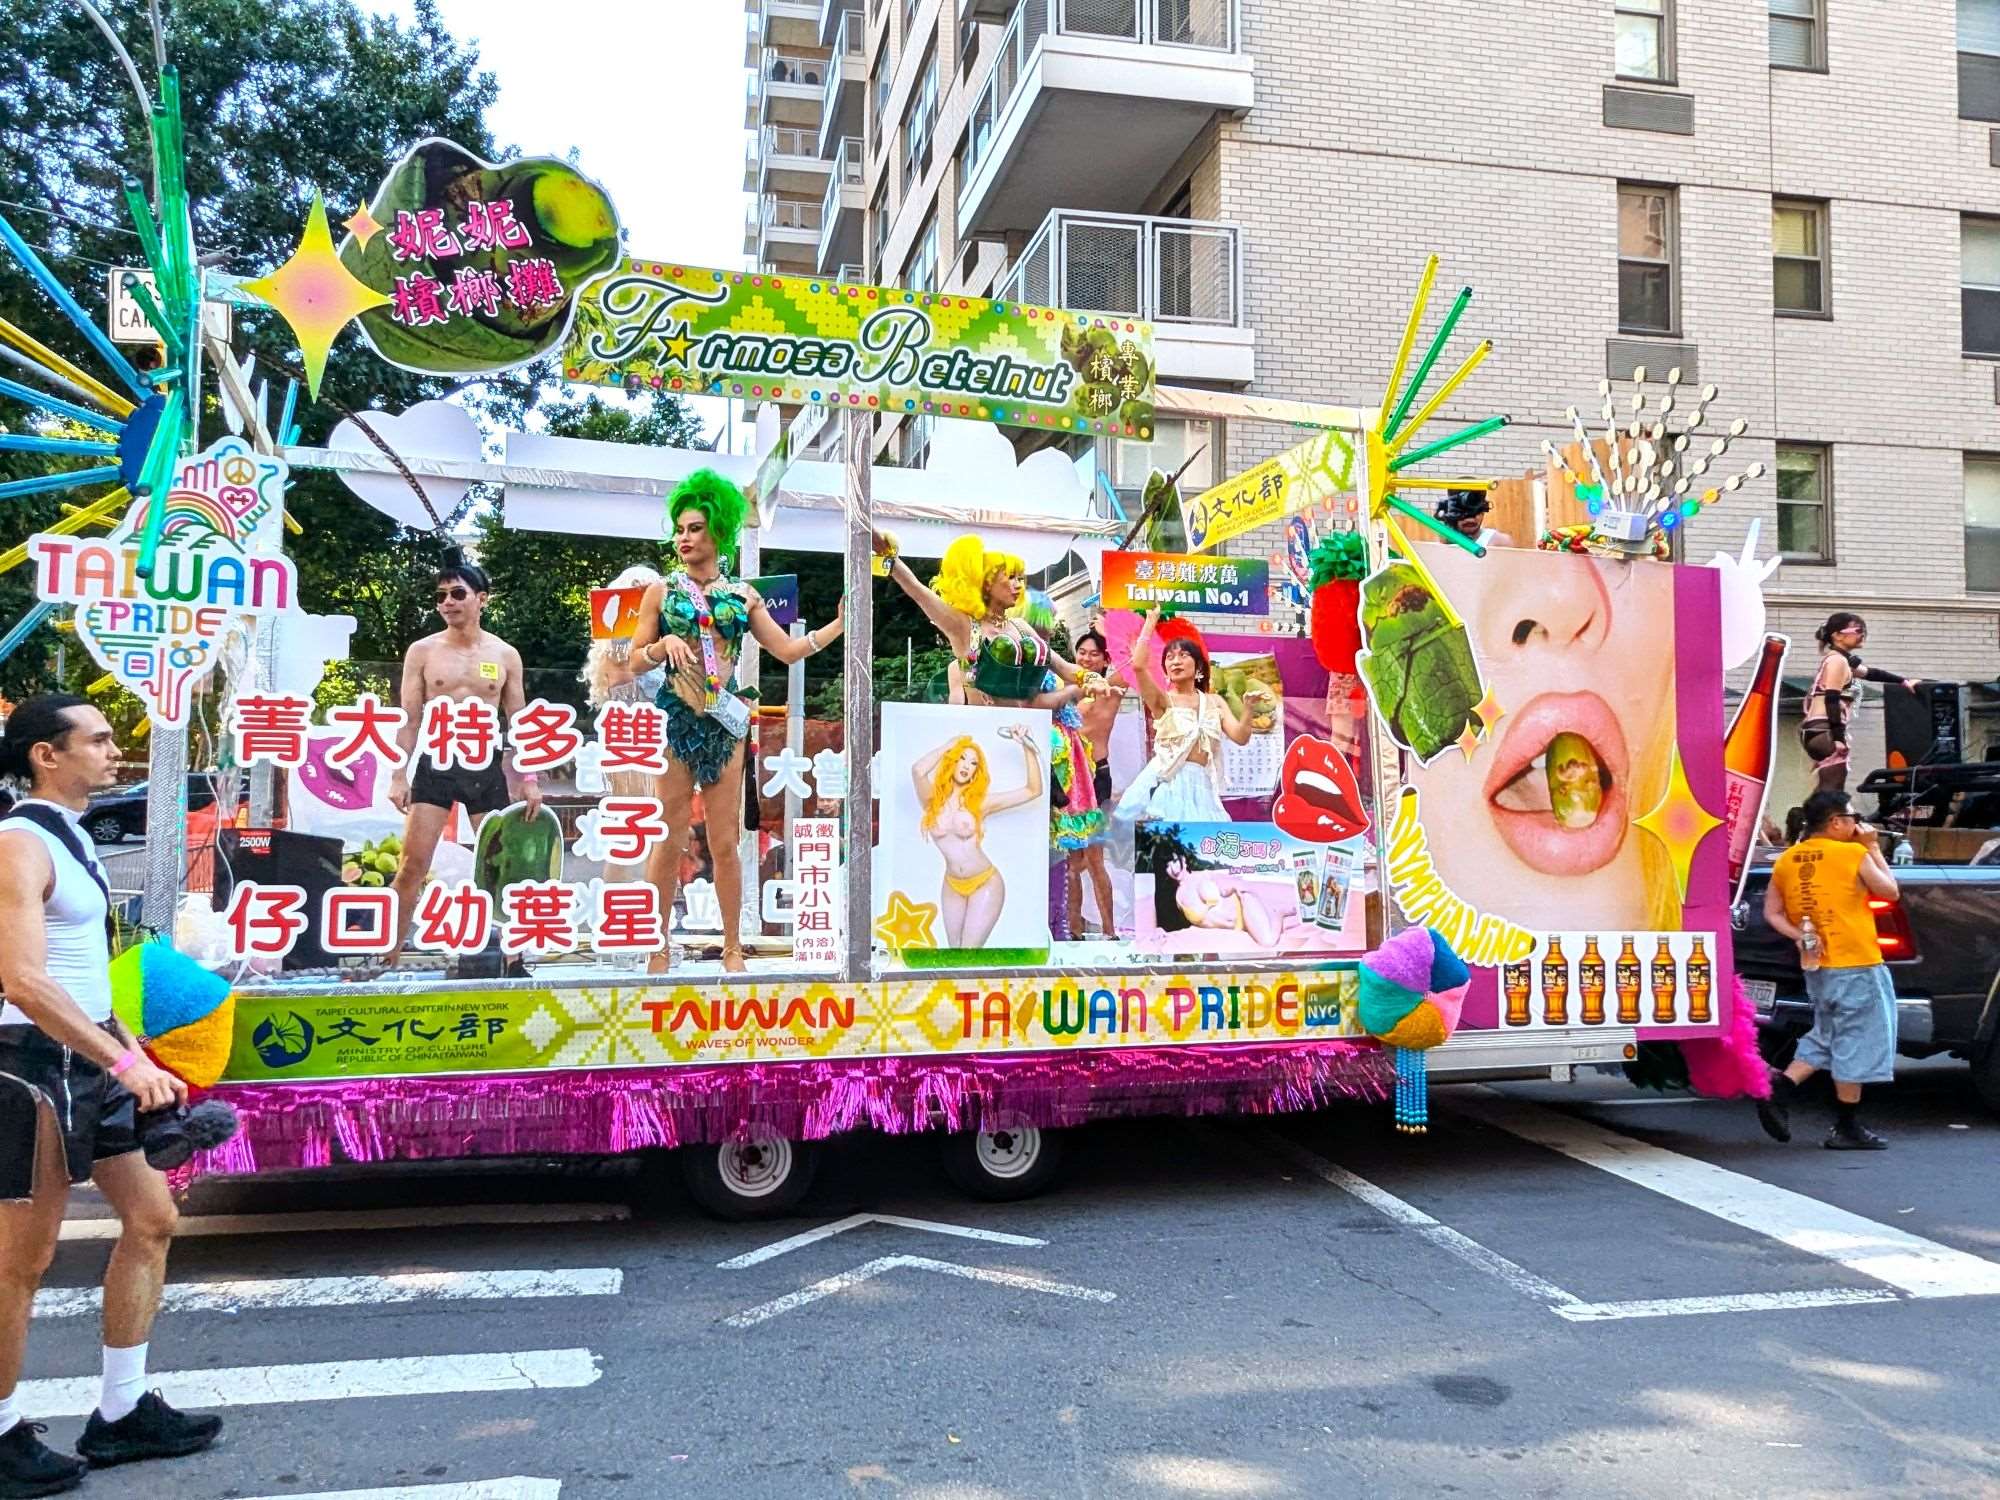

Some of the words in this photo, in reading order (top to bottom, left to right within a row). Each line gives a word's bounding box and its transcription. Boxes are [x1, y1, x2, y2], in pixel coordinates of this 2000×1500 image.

[387, 198, 533, 261] 妮妮
[391, 258, 564, 326] 檳榔攤
[853, 308, 1073, 403] Betelnut
[1209, 474, 1283, 523] 文化部
[1125, 583, 1201, 604] Taiwan
[1205, 587, 1249, 606] No.1
[100, 600, 227, 637] PRIDE
[240, 836, 272, 848] 2500W
[798, 843, 832, 931] 門市小姐
[316, 1007, 346, 1017] TAIPEI
[348, 1006, 402, 1016] CULTURAL
[403, 1004, 443, 1014] CENTER
[457, 1003, 480, 1012] NEW
[482, 1002, 509, 1011] YORK
[641, 997, 855, 1033] TAIWAN
[1165, 984, 1299, 1032] PRIDE
[1307, 1004, 1337, 1019] NYC
[317, 1013, 508, 1046] 文化部
[686, 1039, 730, 1049] WAVES
[734, 1038, 752, 1047] OF
[756, 1036, 815, 1047] WONDER
[336, 1054, 386, 1063] REPUBLIC
[388, 1053, 401, 1062] OF
[337, 1047, 401, 1056] MINISTRY
[406, 1045, 423, 1053] OF
[427, 1043, 486, 1052] CULTURE
